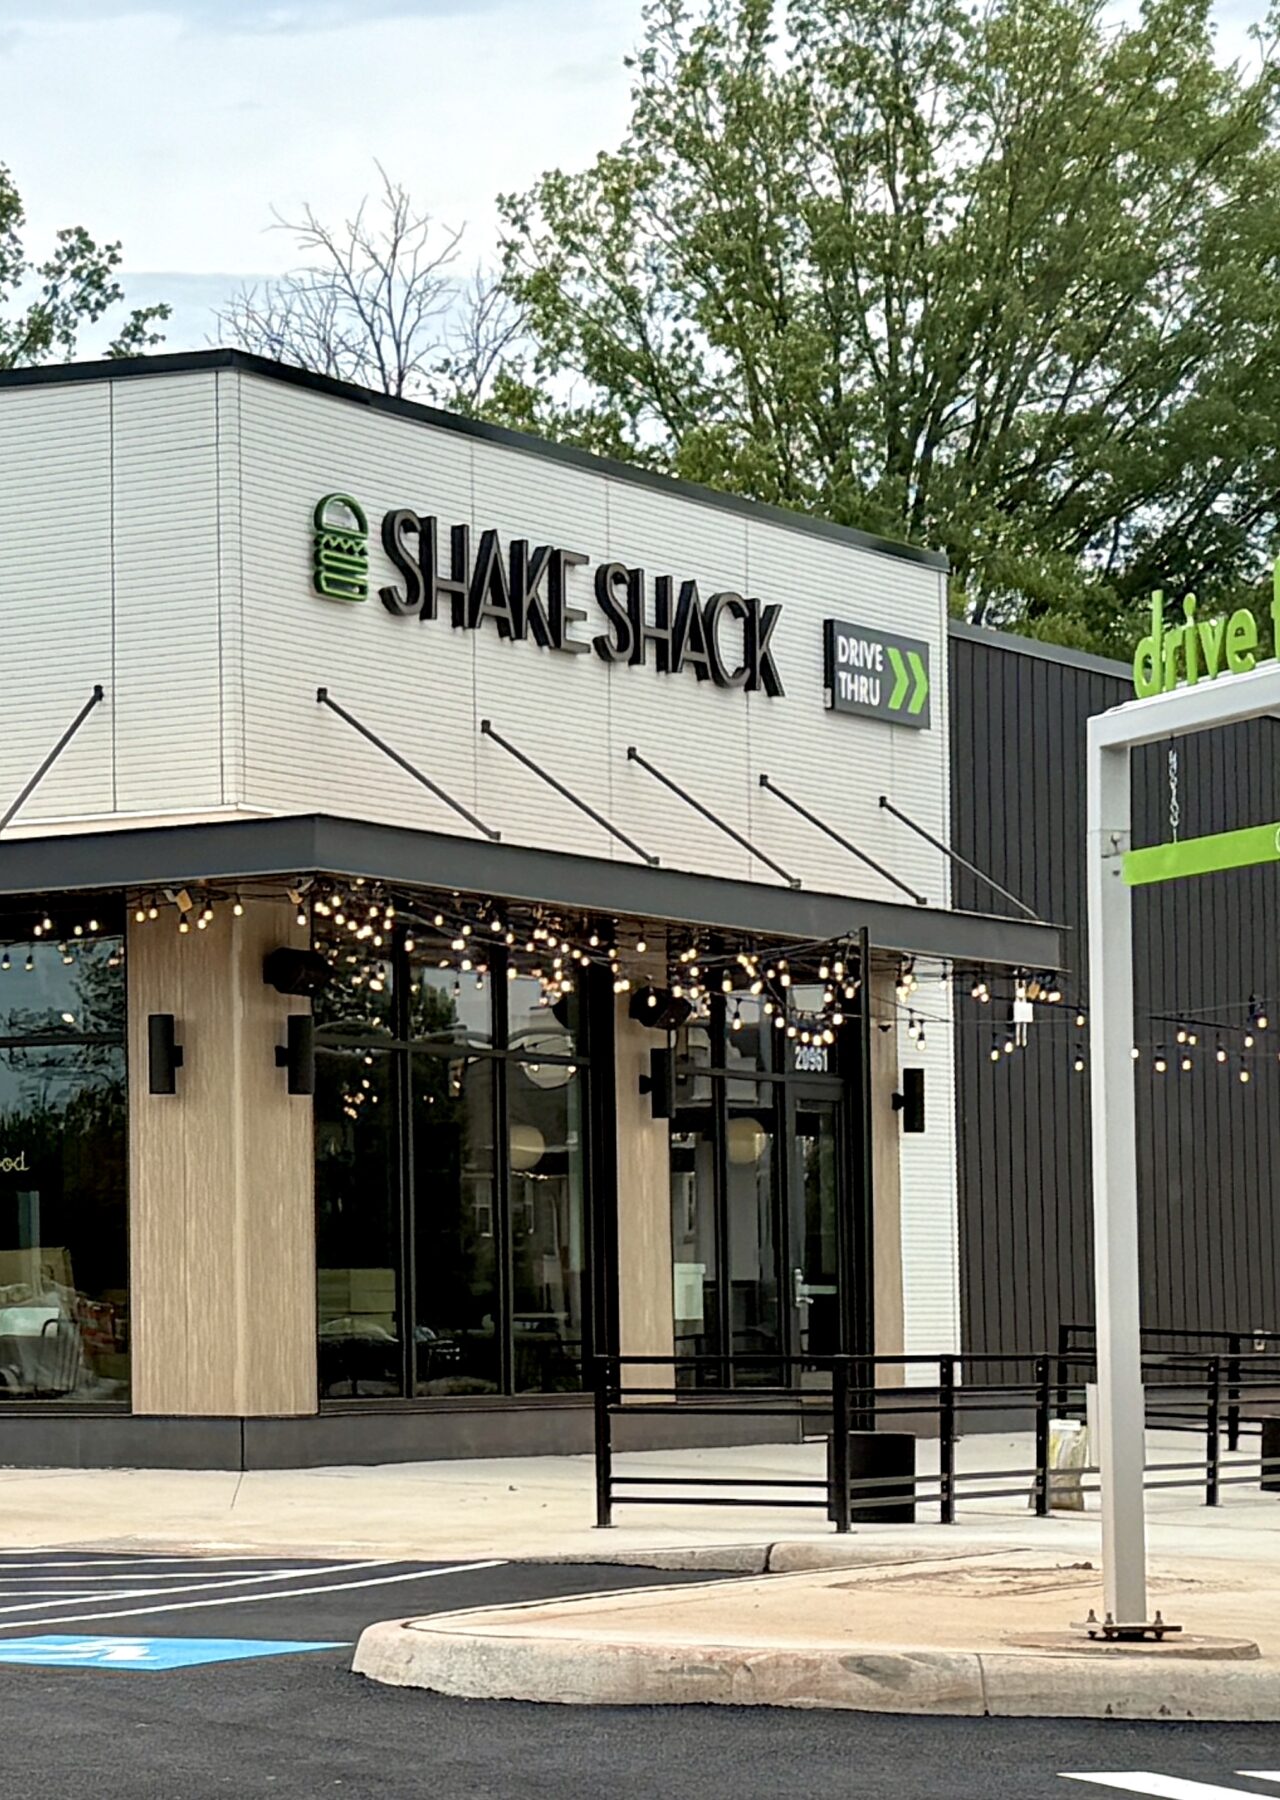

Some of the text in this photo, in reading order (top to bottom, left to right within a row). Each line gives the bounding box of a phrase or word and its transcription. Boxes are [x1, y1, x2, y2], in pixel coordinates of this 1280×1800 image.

[378, 508, 786, 697] SHAKE SHACK
[837, 635, 883, 672] DRIVE
[1133, 590, 1258, 699] drive
[839, 671, 880, 706] THRU
